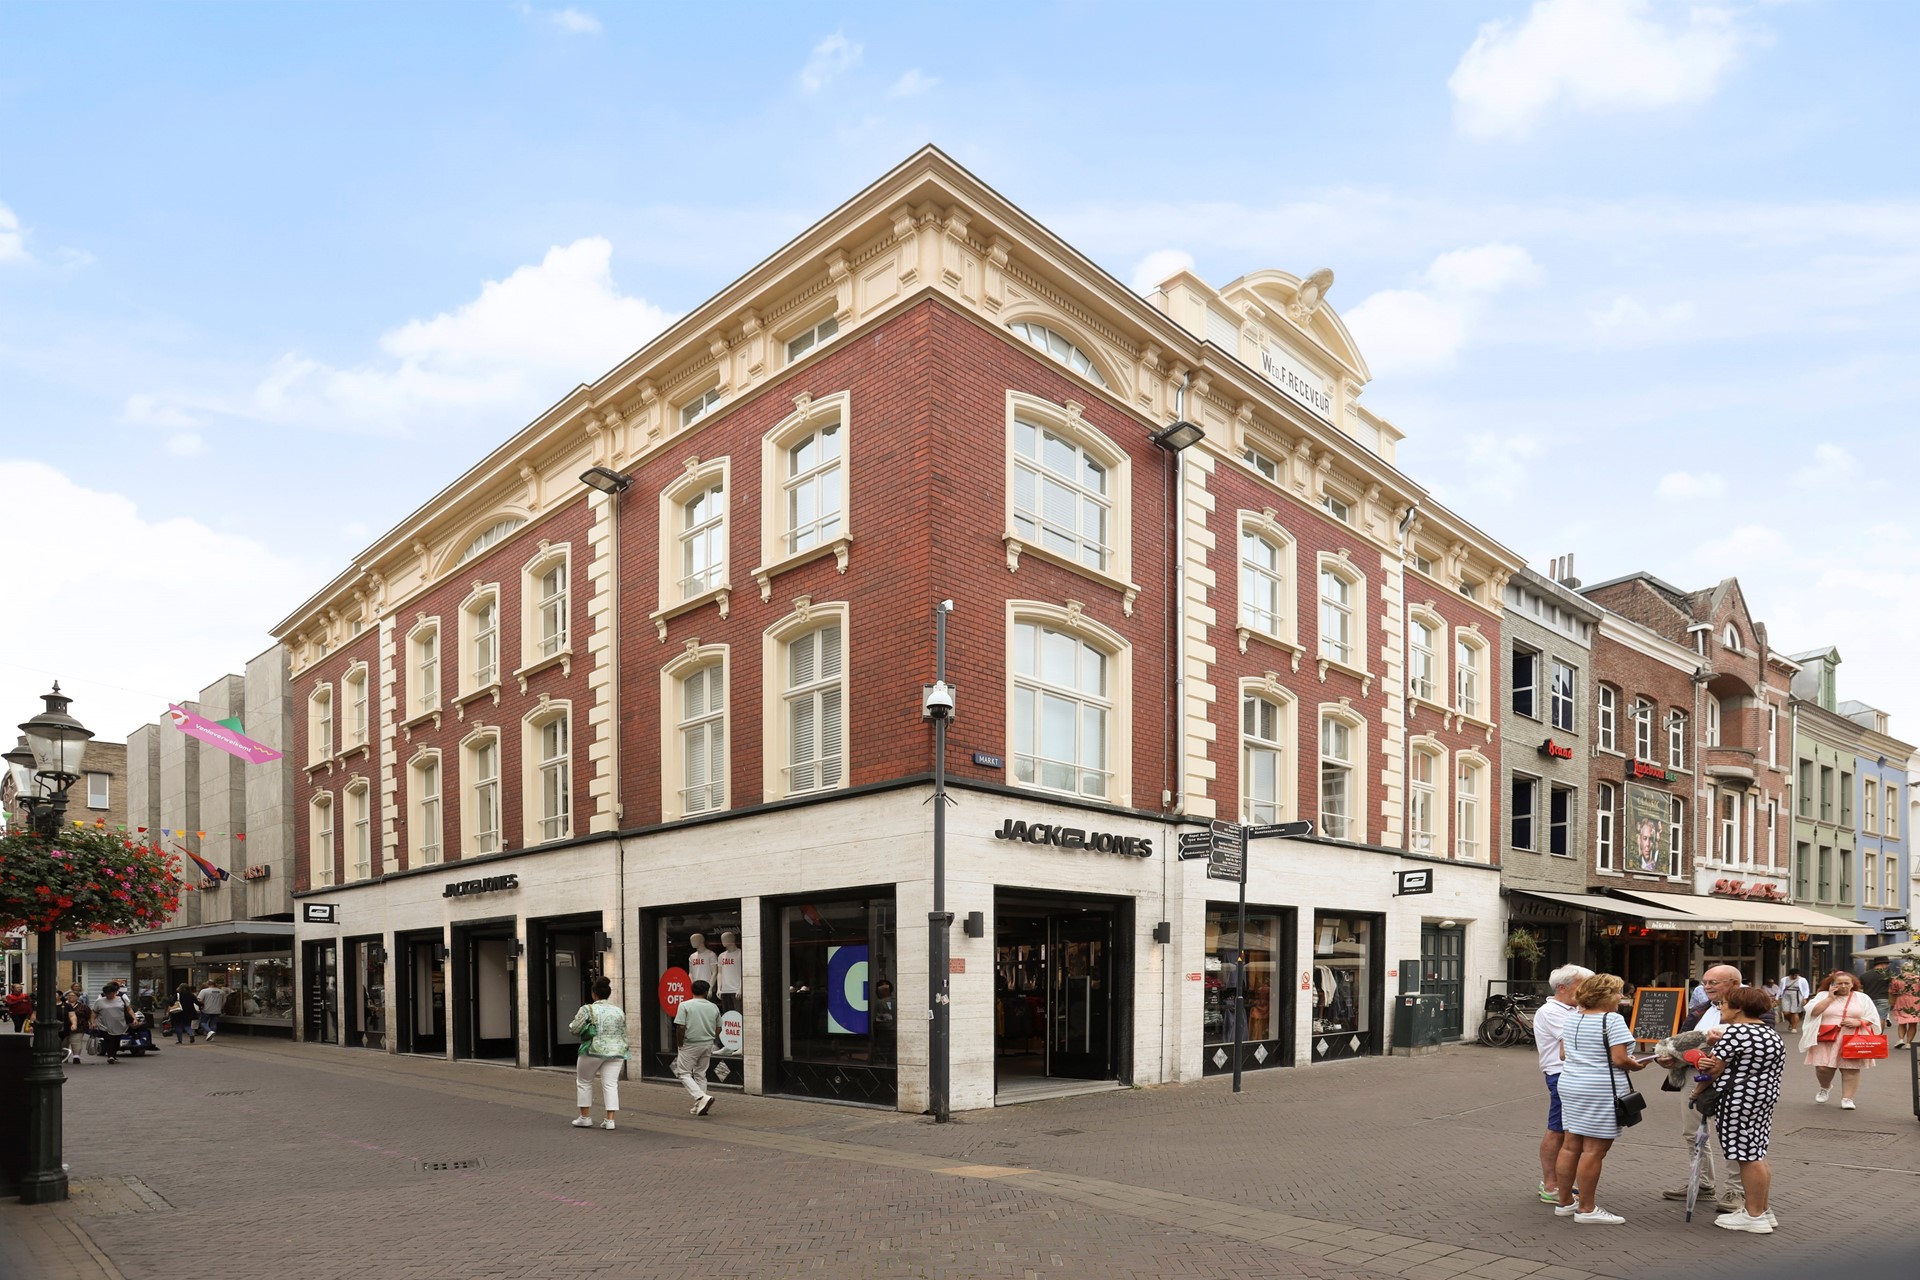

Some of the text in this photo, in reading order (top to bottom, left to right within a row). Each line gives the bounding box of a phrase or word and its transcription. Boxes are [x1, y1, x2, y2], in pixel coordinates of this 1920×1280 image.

[1548, 738, 1573, 759] Brand
[979, 755, 999, 766] MARKT
[1665, 771, 1678, 781] BIER
[995, 819, 1153, 857] JACK JONES
[480, 874, 519, 892] JONES
[1520, 902, 1569, 917] bikmik
[1651, 920, 1677, 930] bikmik
[692, 958, 704, 966] SALE
[721, 958, 734, 966] SALE
[667, 982, 684, 992] 70%
[725, 1028, 741, 1036] SALE
